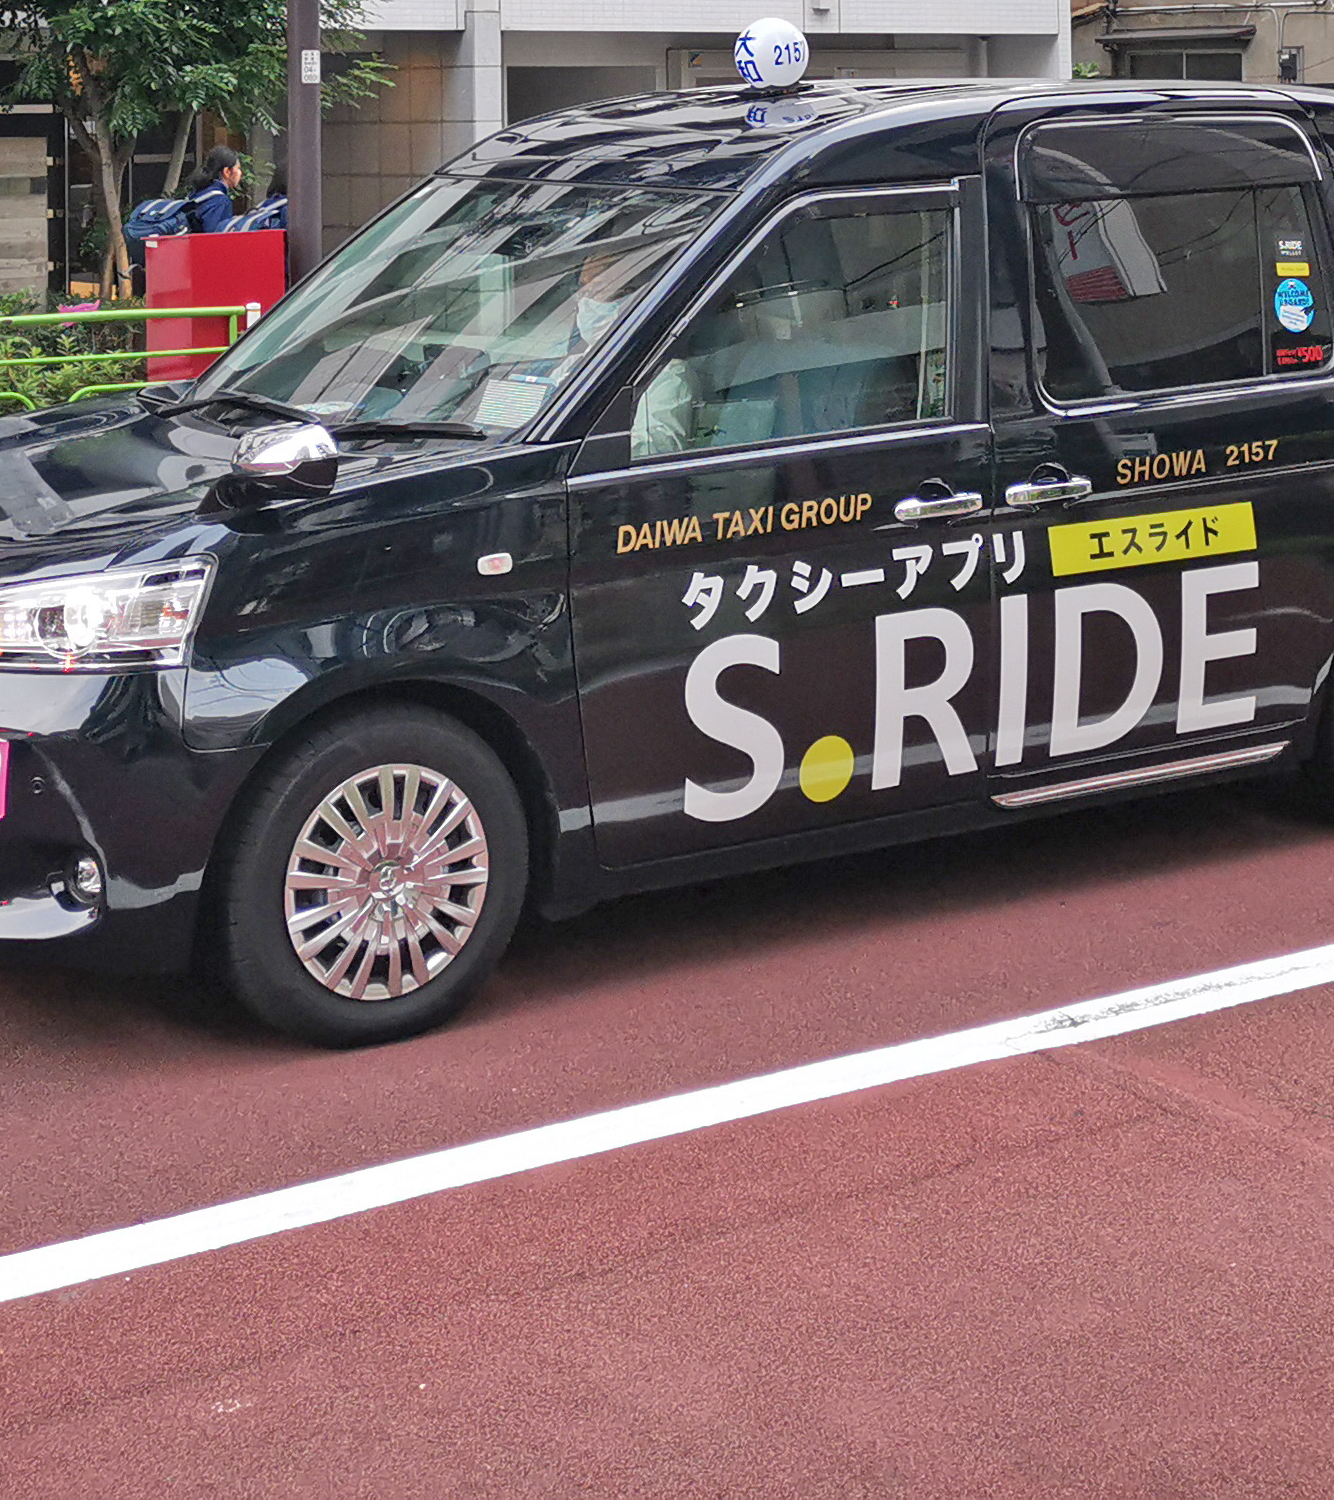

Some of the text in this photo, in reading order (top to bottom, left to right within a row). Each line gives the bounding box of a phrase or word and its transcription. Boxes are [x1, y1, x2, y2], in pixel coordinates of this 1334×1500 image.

[735, 29, 764, 87] 大和
[1116, 440, 1278, 485] SHOWA 2157
[615, 493, 873, 555] DAIWA TAXI GROUP
[1087, 515, 1222, 560] エスライド
[681, 530, 1027, 630] タクシーアプリ
[683, 561, 1260, 823] S.RIDE
